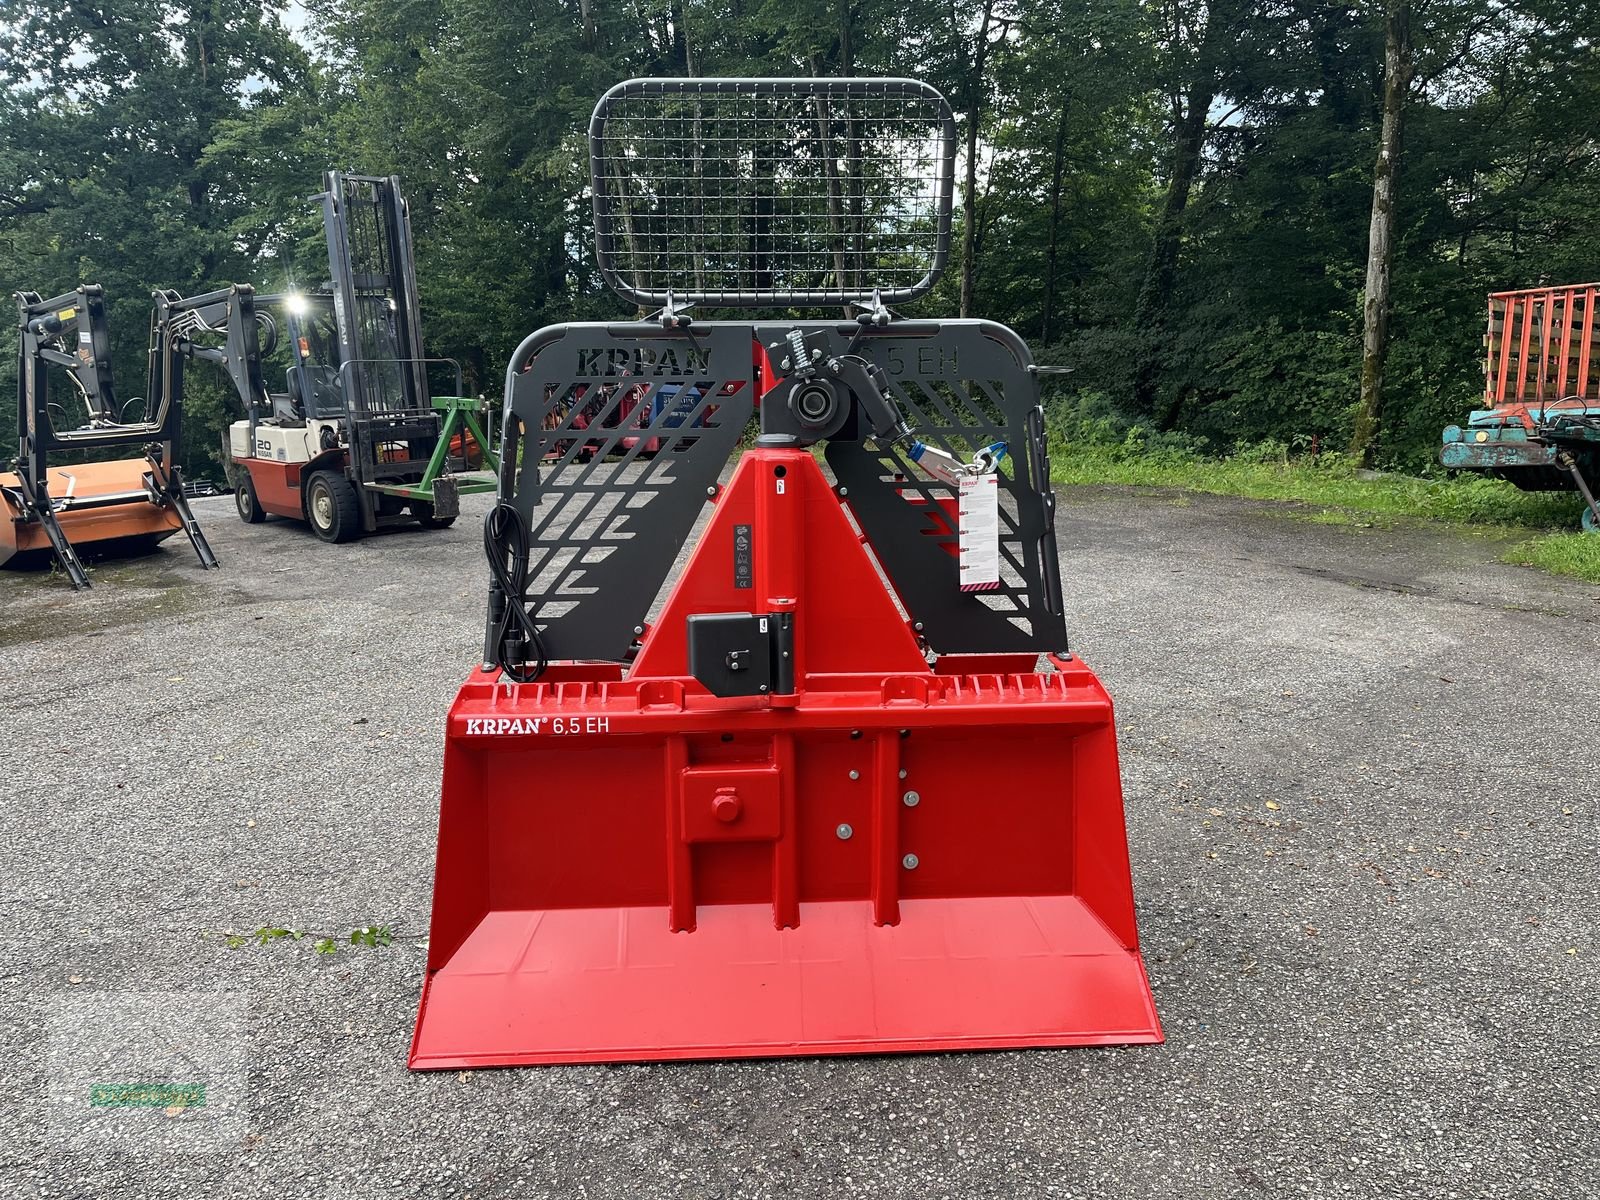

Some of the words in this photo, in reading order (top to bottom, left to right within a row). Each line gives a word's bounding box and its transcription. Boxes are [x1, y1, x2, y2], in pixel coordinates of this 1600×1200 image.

[576, 348, 711, 377] KRPAN
[918, 346, 958, 375] EH
[257, 439, 271, 450] 20
[257, 450, 273, 458] NISSAN
[553, 717, 580, 735] 6,5
[586, 717, 609, 733] EH
